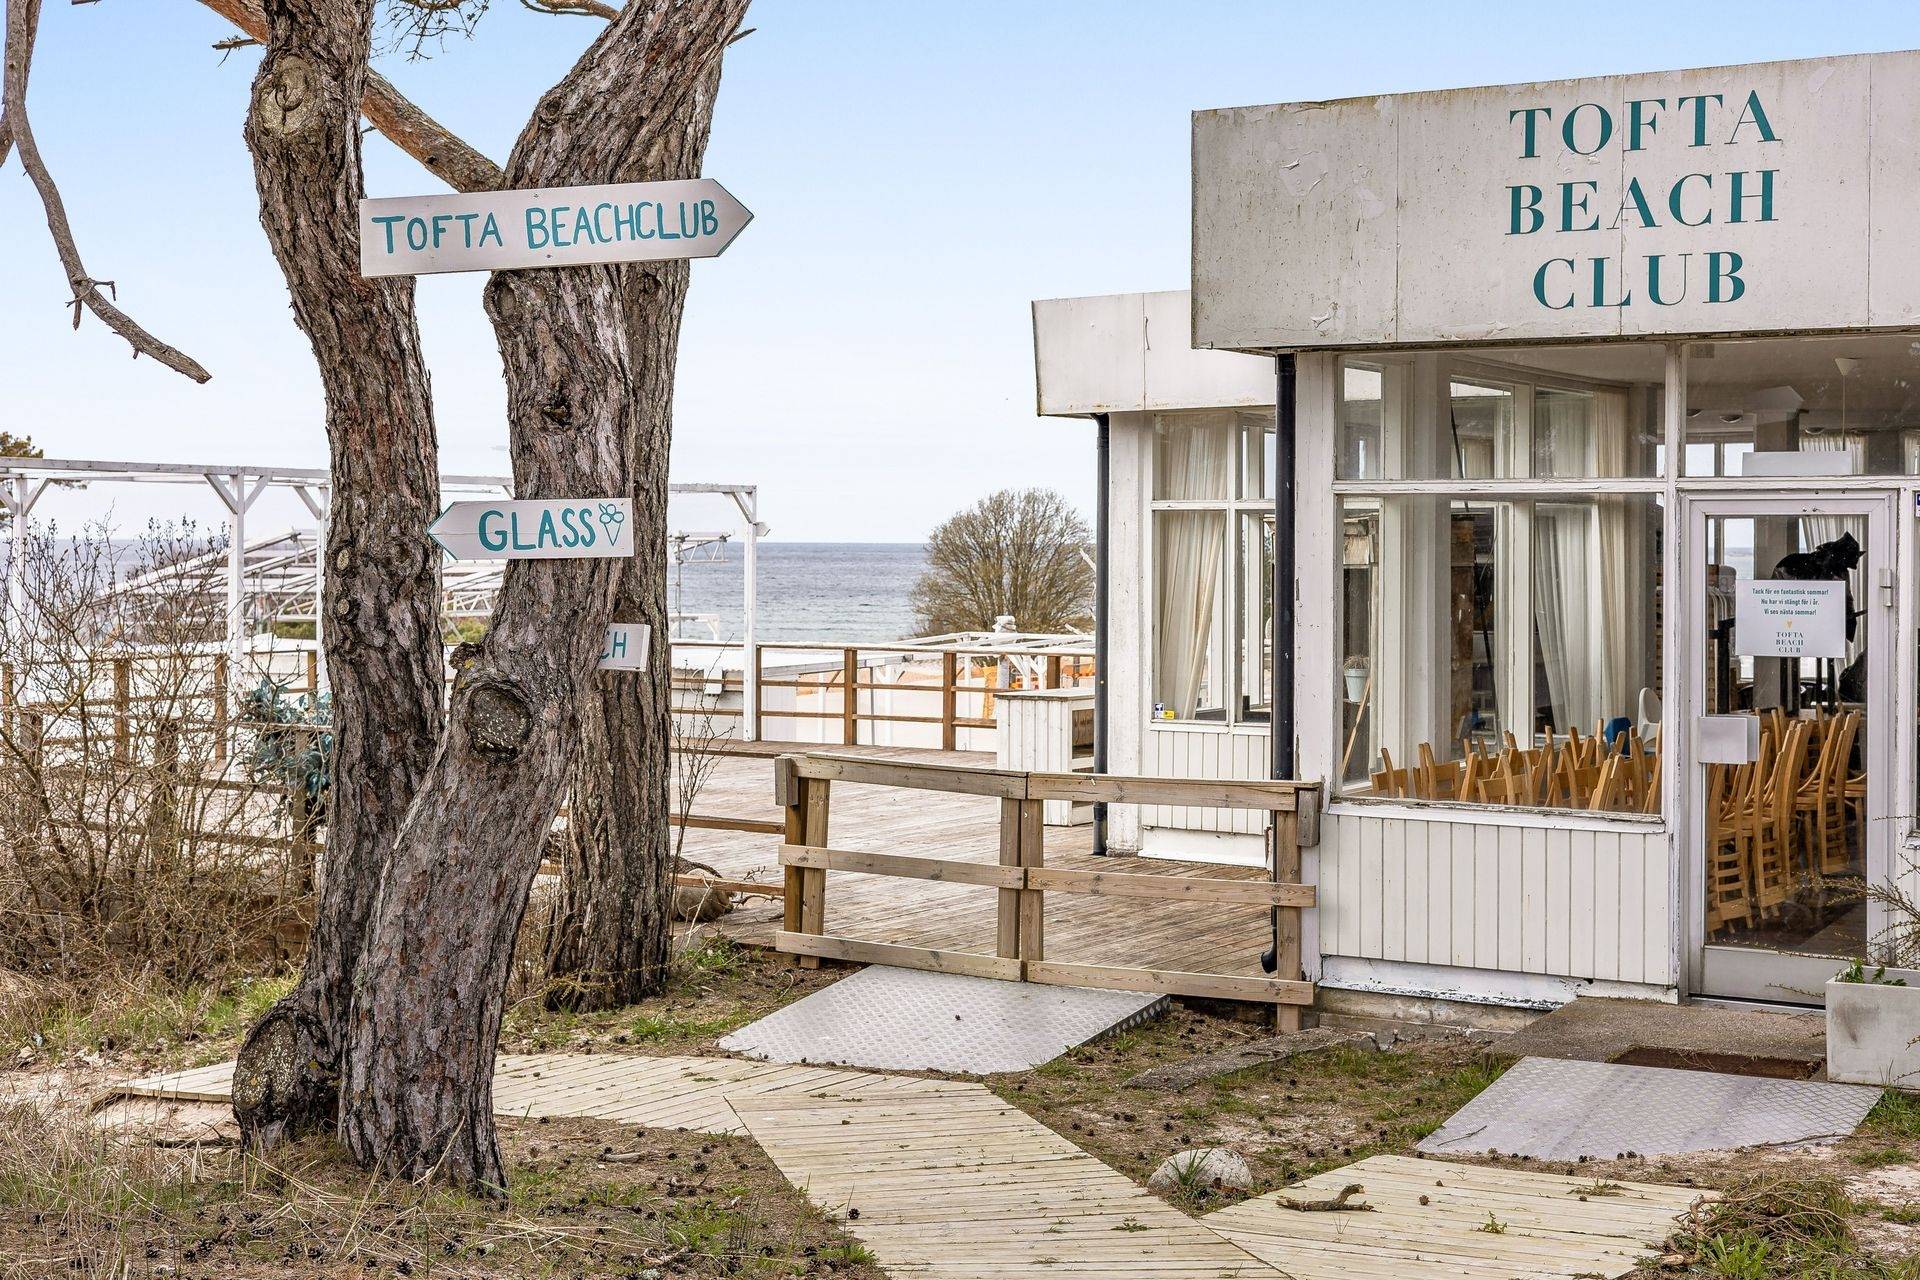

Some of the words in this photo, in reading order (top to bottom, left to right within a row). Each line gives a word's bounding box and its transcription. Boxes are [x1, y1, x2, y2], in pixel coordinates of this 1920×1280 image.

[1509, 89, 1782, 159] TOFTA
[371, 211, 504, 254] TOFTA
[526, 199, 720, 250] BEACHCLUB
[1504, 169, 1780, 235] BEACH
[1532, 251, 1746, 310] CLUB
[478, 507, 597, 551] GLASS
